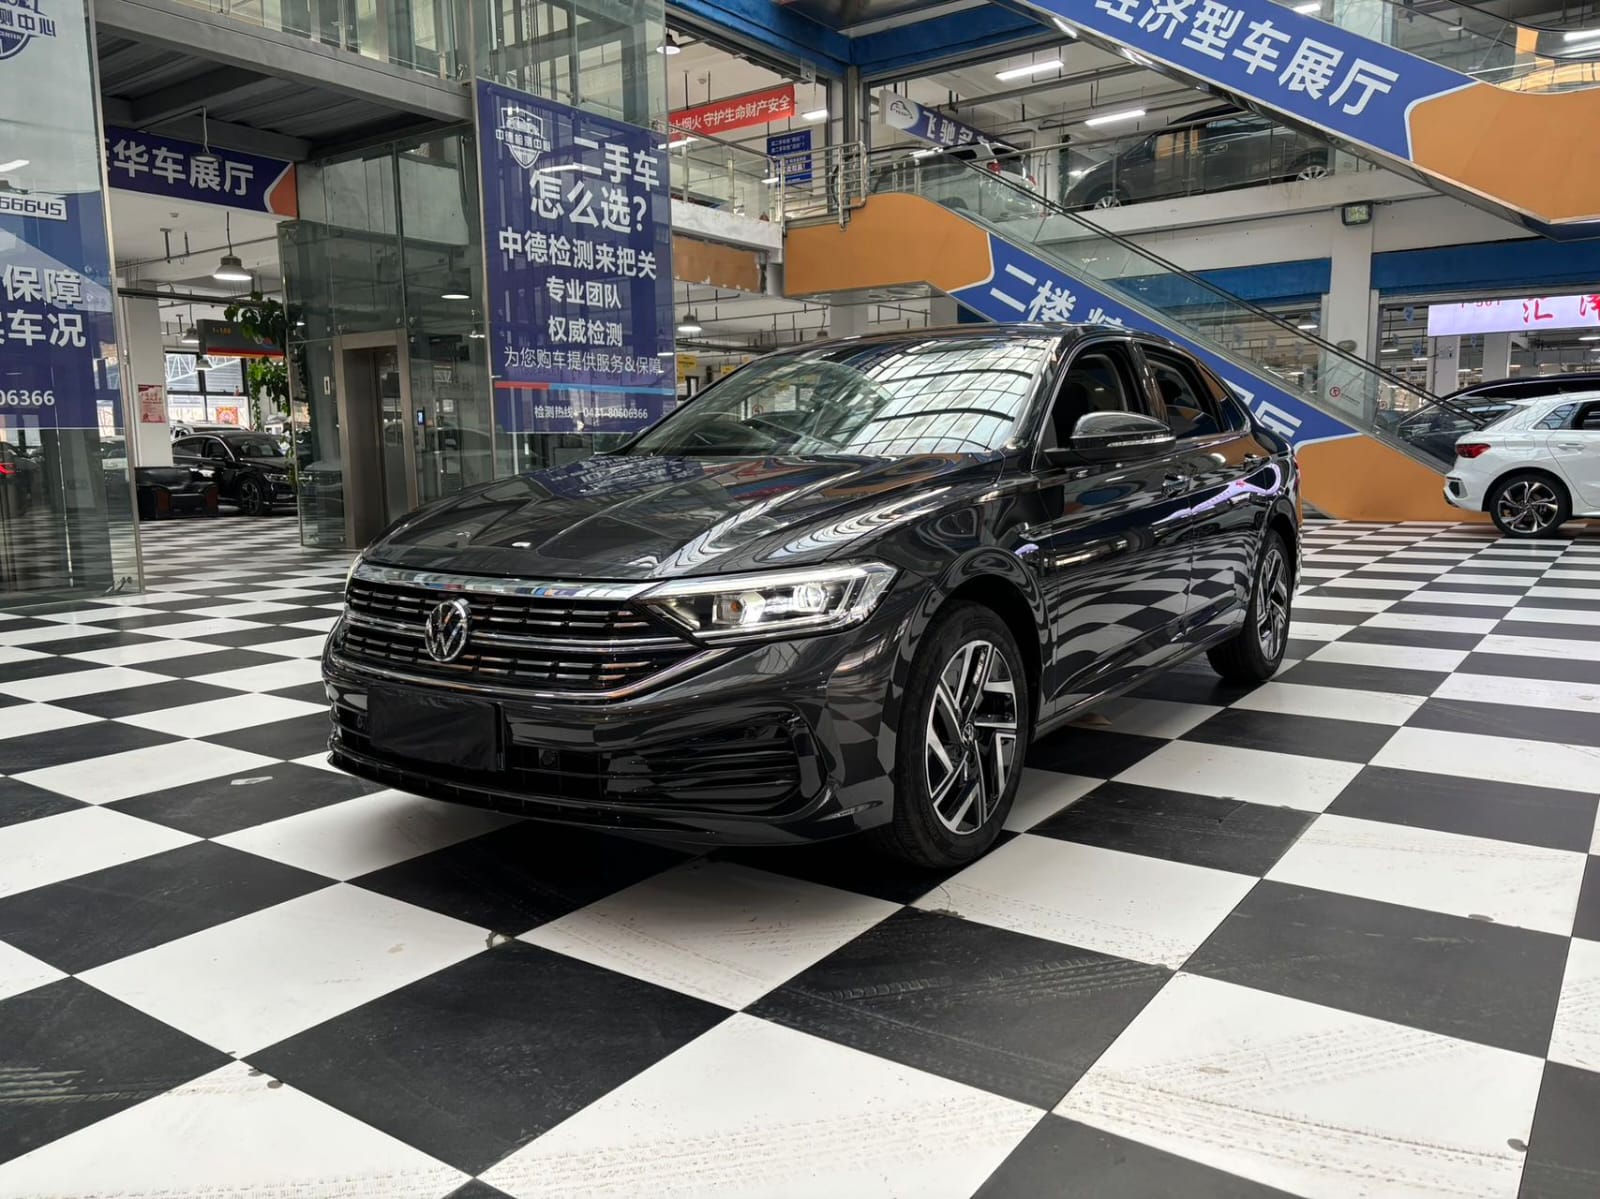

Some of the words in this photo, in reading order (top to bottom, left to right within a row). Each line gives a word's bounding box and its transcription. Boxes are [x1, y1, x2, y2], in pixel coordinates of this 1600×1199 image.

[703, 95, 791, 127] 守护生命财产安全
[105, 137, 254, 196] 华车展厅
[573, 136, 660, 192] 二手车
[499, 226, 657, 281] 中德检测来把关
[2, 263, 84, 305] 保障
[546, 275, 622, 310] 专业团队
[0, 308, 87, 348] 车况
[548, 315, 623, 347] 权威检测
[503, 346, 663, 376] 为您购车提供服务&保障
